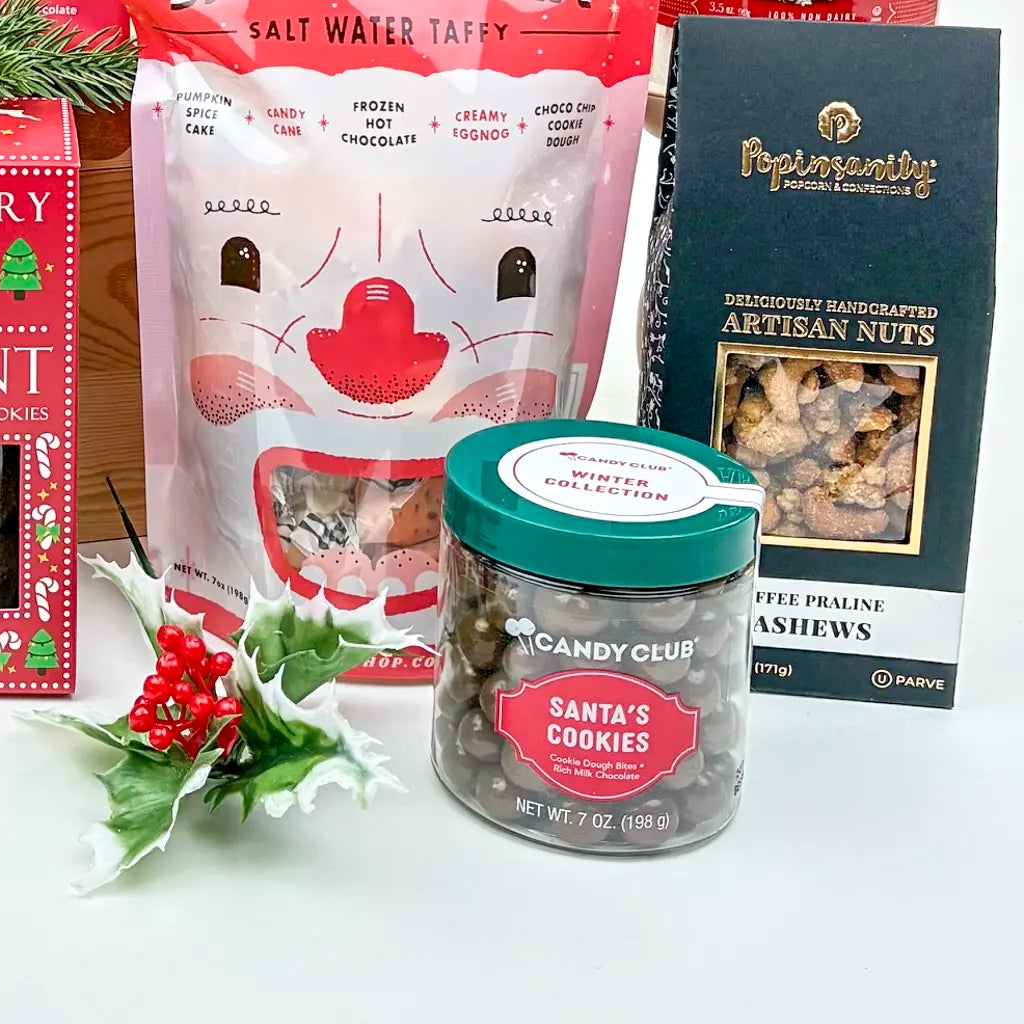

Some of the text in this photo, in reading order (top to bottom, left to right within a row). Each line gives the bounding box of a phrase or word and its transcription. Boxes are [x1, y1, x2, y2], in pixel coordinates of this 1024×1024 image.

[249, 15, 509, 45] SALT WATER TAFFY
[176, 91, 232, 106] PUMPKIN
[186, 108, 218, 119] SPICE
[267, 108, 305, 120] CANDY
[353, 100, 405, 113] FROZEN
[535, 102, 595, 116] CHOCO CHIP
[366, 118, 392, 129] HOT
[456, 110, 507, 122] CREAMY
[186, 124, 214, 136] CAKE
[274, 124, 302, 136] CANE
[548, 119, 583, 131] COOKIE
[341, 133, 417, 147] CHOCOLATE
[453, 128, 509, 141] EGGNOG
[547, 135, 579, 147] DOUGH
[784, 180, 911, 196] POPCORN CONFECTIONS
[724, 294, 938, 319] DELICIOUSLY HANDCRAFTED
[722, 312, 935, 346] ARTISAN NUTS
[571, 470, 649, 487] WINTER
[544, 477, 669, 501] COLLECTION
[806, 596, 884, 612] PRALINE
[753, 615, 871, 641] ASHEWS
[535, 633, 627, 662] CANDY
[755, 662, 792, 677] (171g)
[896, 676, 944, 690] PARVE
[550, 696, 649, 725] SANTA'S
[547, 723, 649, 752] COOKIES
[550, 754, 638, 771] Cookie Dough Bites
[553, 765, 640, 780] Rich Milk Chocolate
[516, 797, 669, 832] NET WT. 7 OZ. (198 g)
